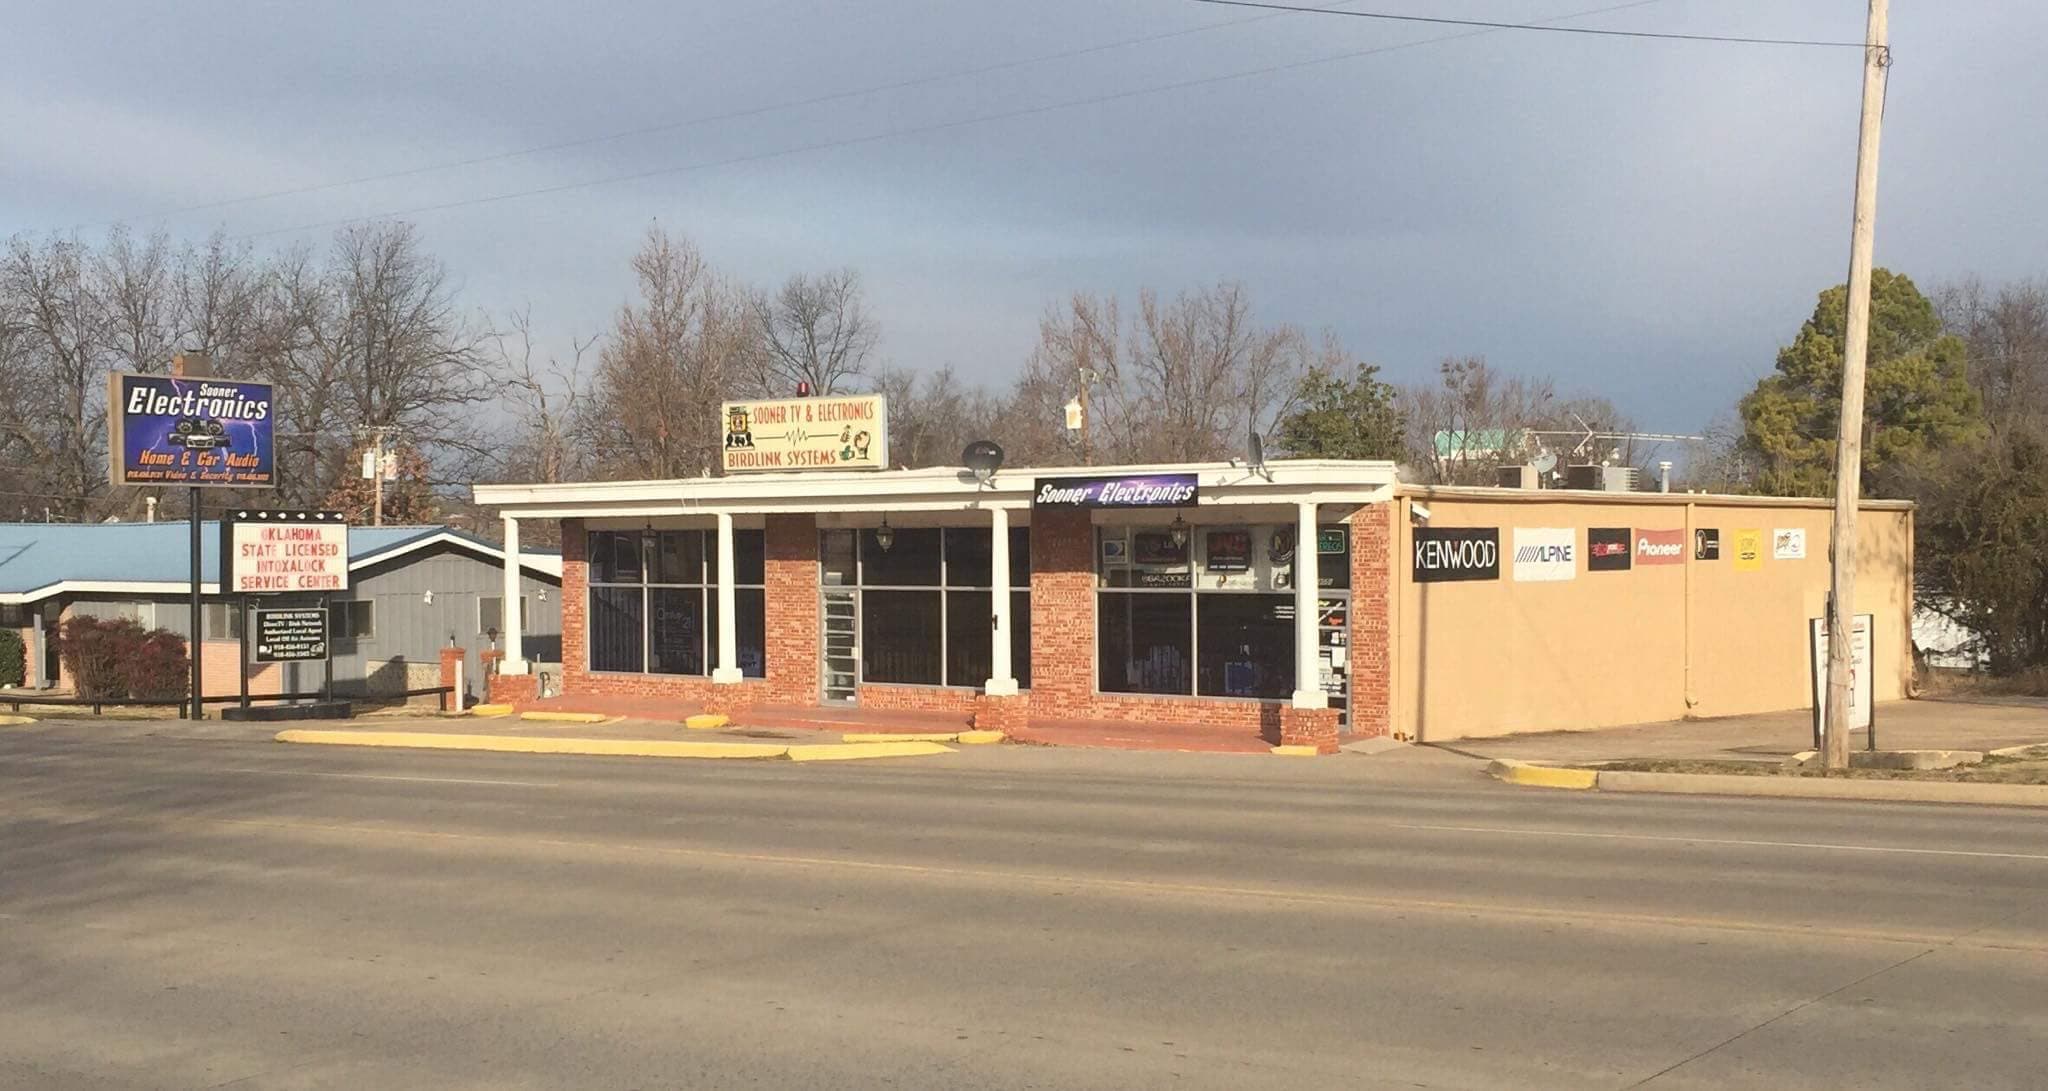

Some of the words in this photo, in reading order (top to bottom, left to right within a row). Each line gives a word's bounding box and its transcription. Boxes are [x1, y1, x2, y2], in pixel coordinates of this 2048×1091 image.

[200, 383, 237, 398] Sooner
[128, 386, 268, 420] Electronics
[753, 406, 786, 424] SOONER
[790, 405, 801, 423] TV
[805, 405, 813, 422] &
[818, 401, 874, 422] ELECTRONICS
[140, 451, 175, 465] Home
[197, 451, 221, 465] Car
[226, 452, 260, 468] Audio
[728, 451, 782, 468] BIRDLINK
[788, 449, 836, 465] SYSTEMS
[165, 470, 187, 480] Video
[200, 470, 233, 482] Security
[1036, 483, 1092, 504] Sooner
[1098, 482, 1195, 503] Electronics
[261, 528, 322, 540] OKLAHOMA
[242, 544, 277, 557] STATE
[285, 544, 338, 556] LICENSED
[1415, 540, 1496, 569] KENWOOD
[1515, 545, 1572, 563] ALPINE
[1638, 538, 1683, 556] Pioneer
[257, 560, 325, 573] INTOXALOCK
[240, 576, 289, 589] SERVICE
[298, 575, 340, 588] CENTER
